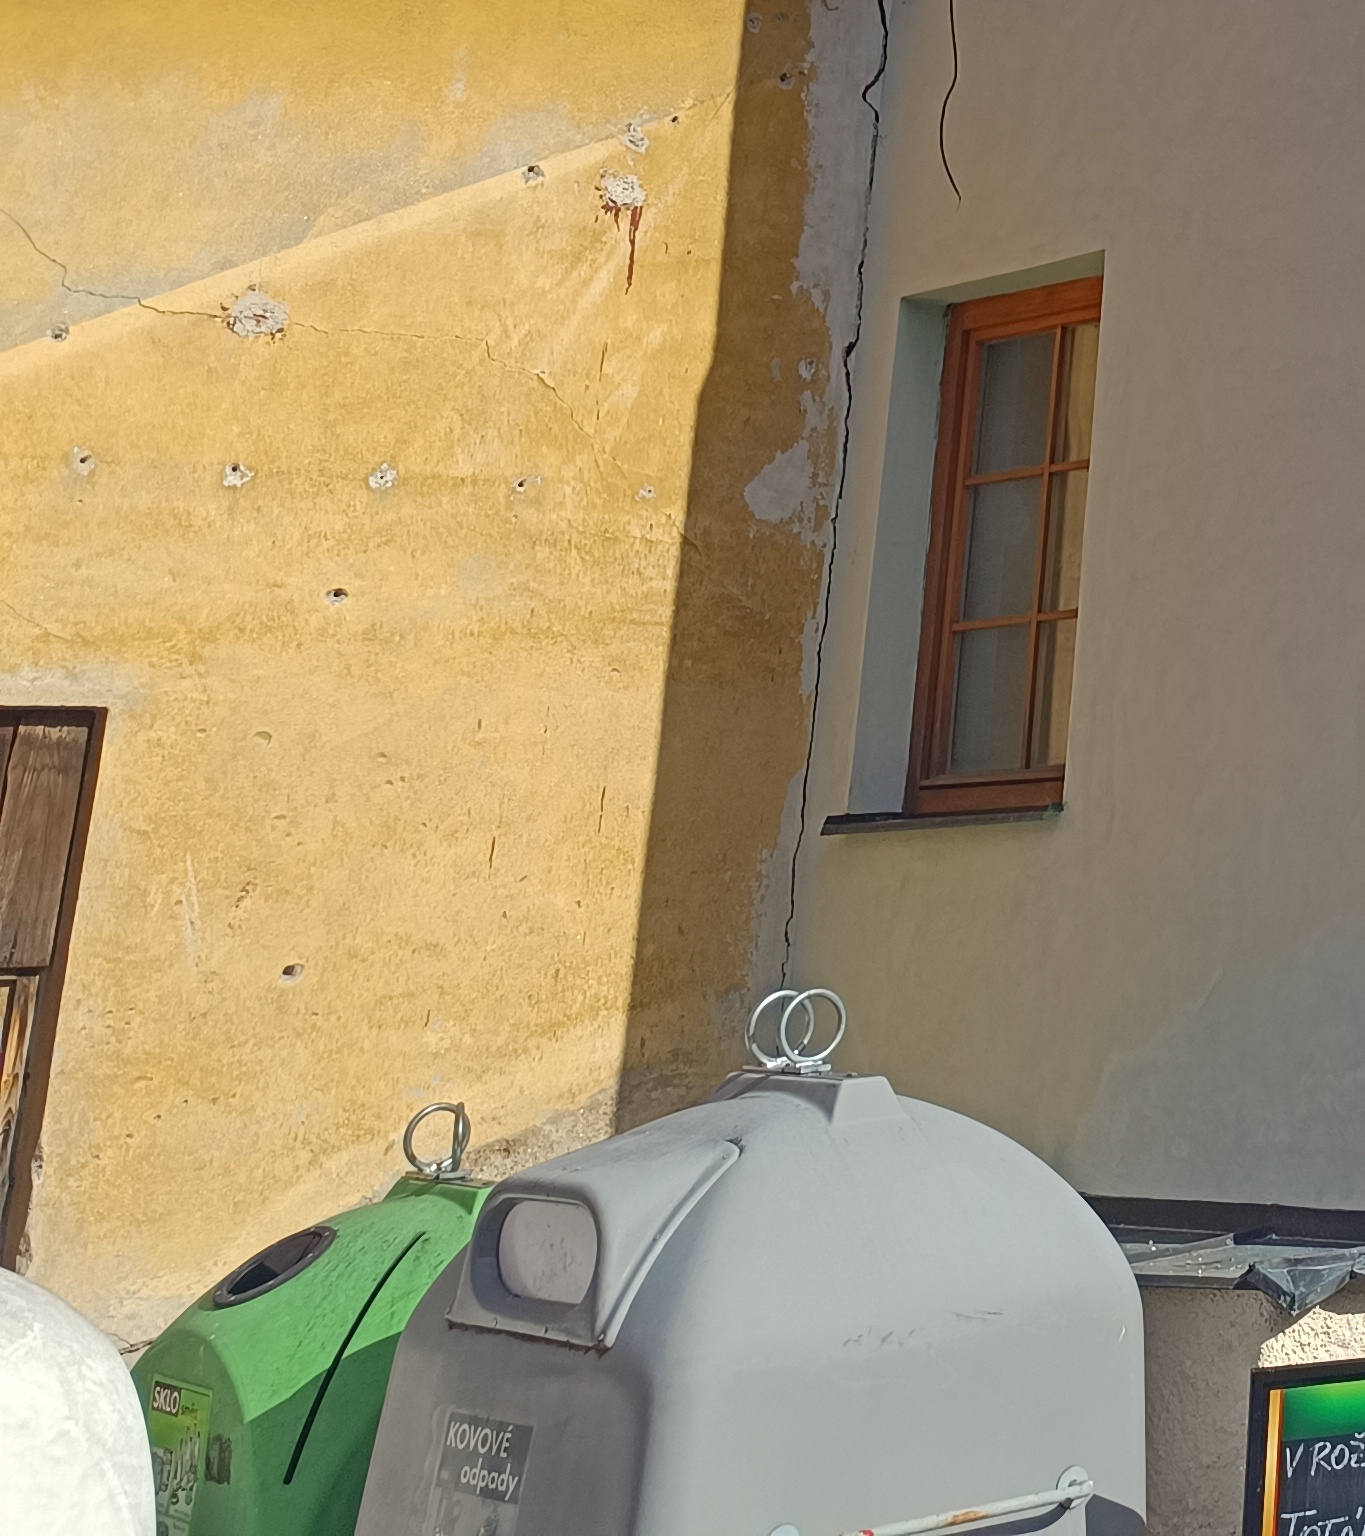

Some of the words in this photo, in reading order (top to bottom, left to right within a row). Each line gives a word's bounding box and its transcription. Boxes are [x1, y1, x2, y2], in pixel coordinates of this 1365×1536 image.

[153, 1386, 180, 1414] SKLO
[446, 1421, 512, 1458] KOVOVÉ
[460, 1457, 519, 1501] odpady
